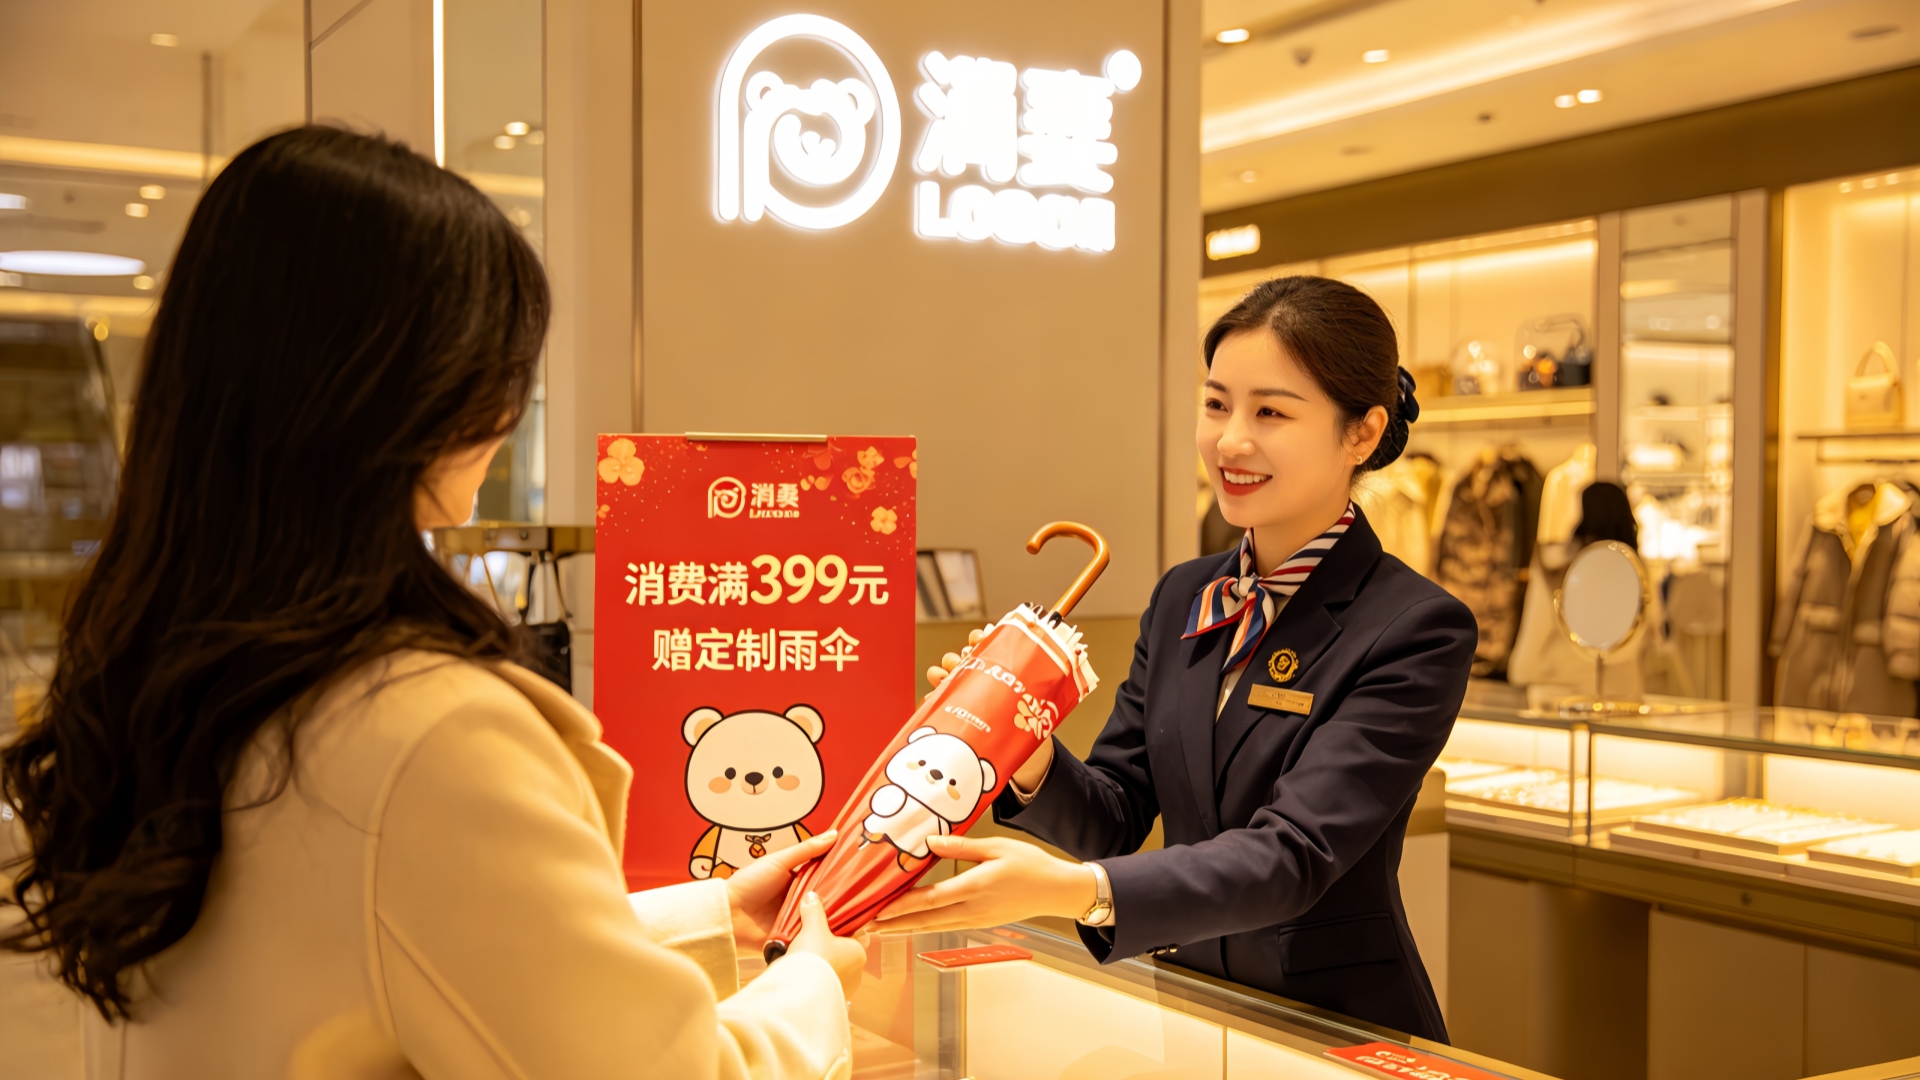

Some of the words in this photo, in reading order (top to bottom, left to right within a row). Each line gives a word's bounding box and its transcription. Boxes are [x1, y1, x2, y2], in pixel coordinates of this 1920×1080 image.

[624, 554, 889, 606] 消费满399元
[652, 626, 860, 672] 赠定制雨伞
